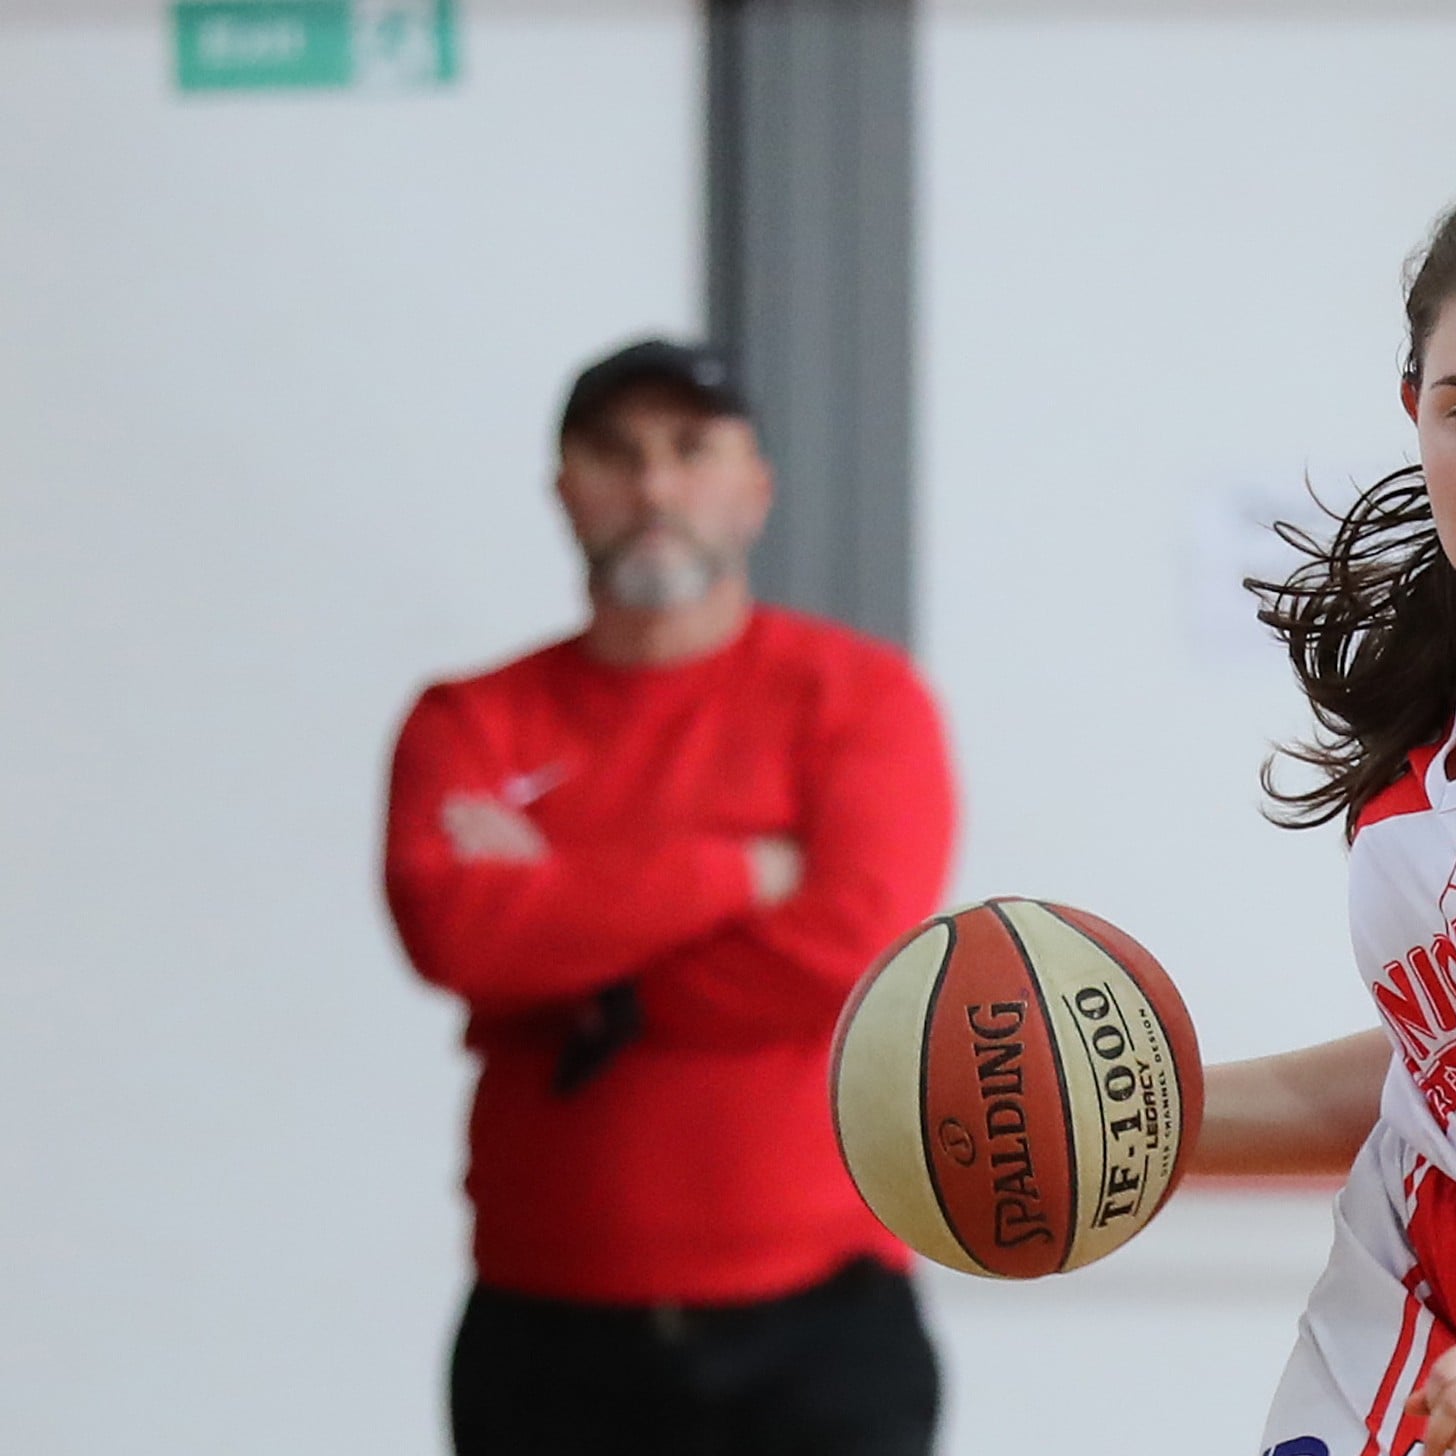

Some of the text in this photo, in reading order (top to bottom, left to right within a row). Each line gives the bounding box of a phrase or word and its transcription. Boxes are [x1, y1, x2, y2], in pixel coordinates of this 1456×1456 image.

[964, 1000, 1055, 1250] SPALDING
[1076, 986, 1143, 1229] TF-1000
[1136, 1056, 1159, 1150] LEGACY
